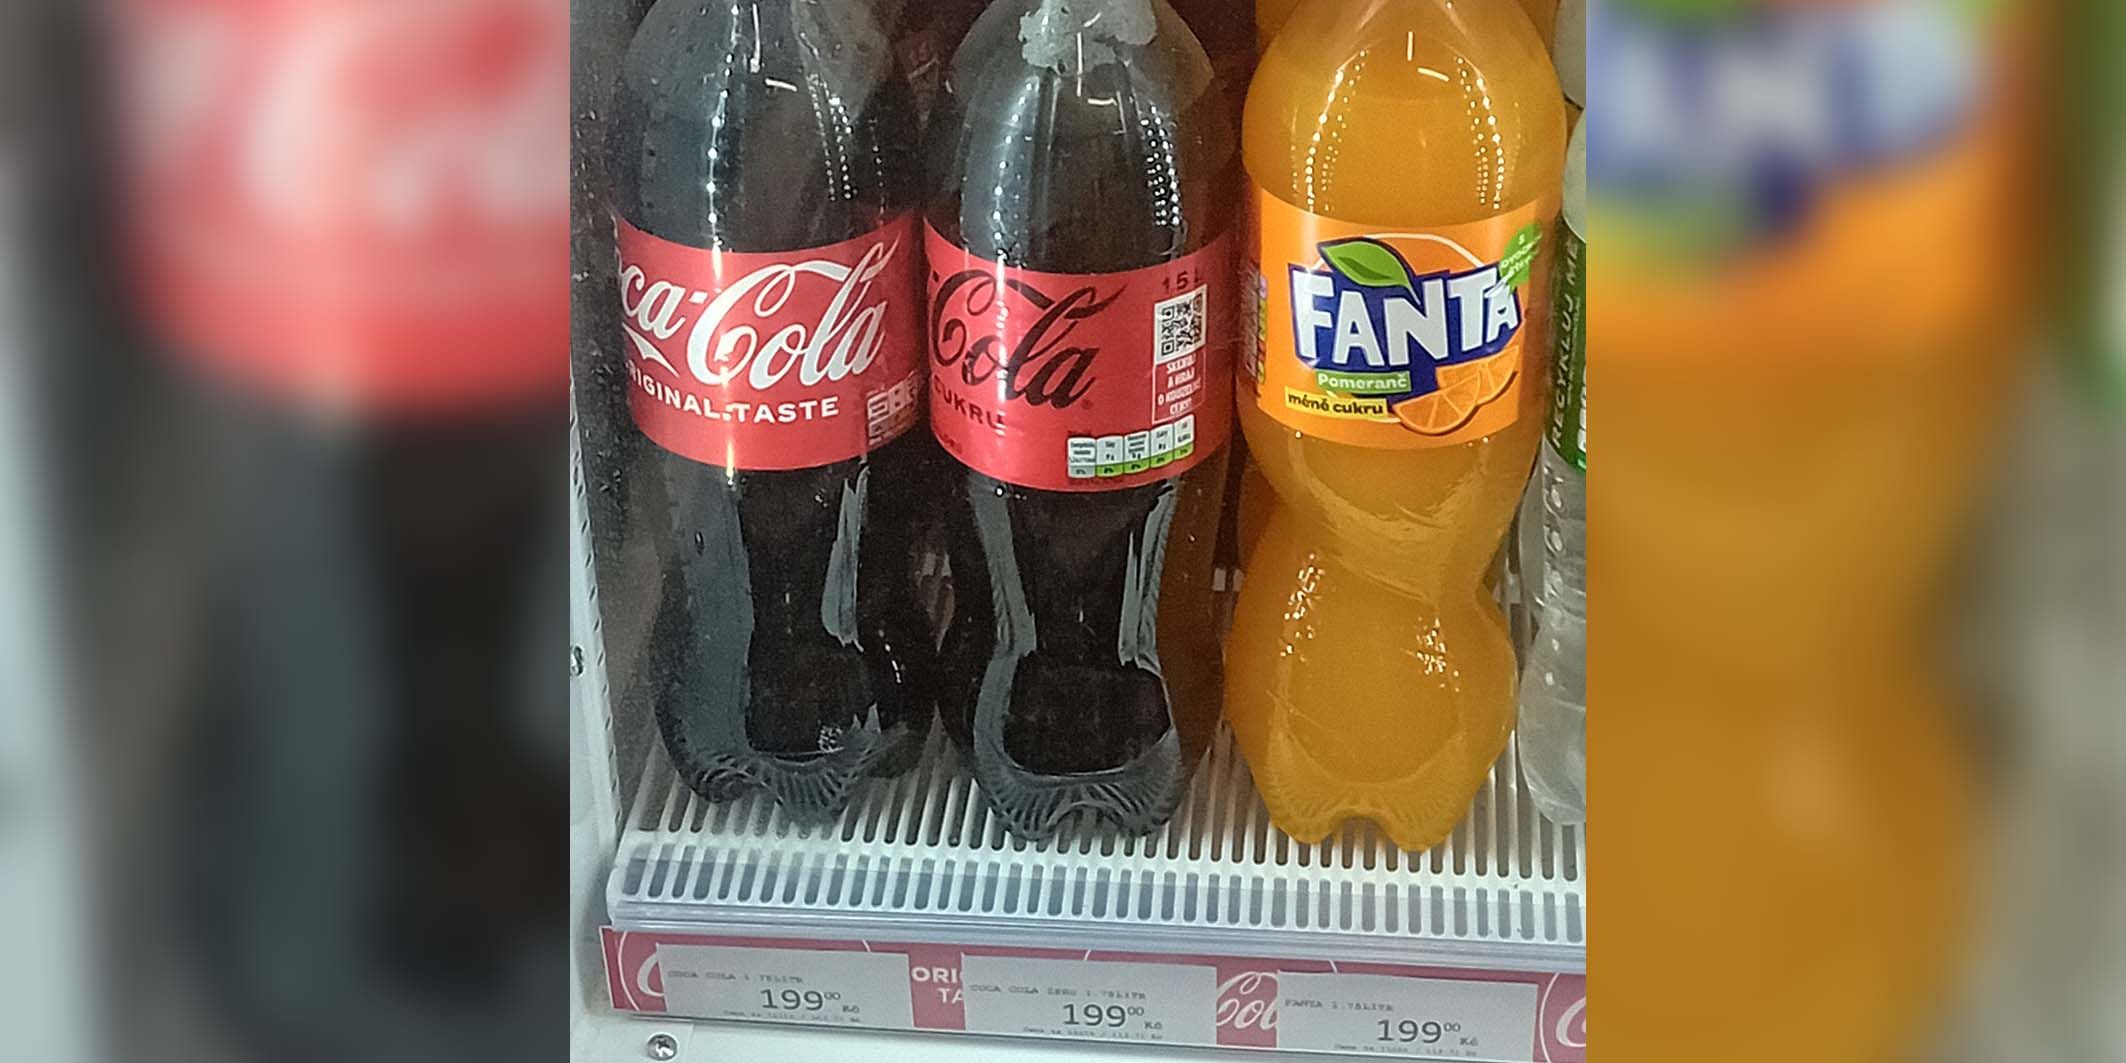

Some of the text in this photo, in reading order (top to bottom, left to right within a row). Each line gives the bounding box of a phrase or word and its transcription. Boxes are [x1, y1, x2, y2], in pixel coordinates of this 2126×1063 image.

[1291, 267, 1520, 367] FANTA
[625, 359, 723, 419] RIGINAL
[730, 397, 839, 423] TASTE
[1317, 372, 1408, 389] Pomeranč
[1333, 399, 1384, 414] cukru
[911, 966, 962, 984] ORI
[761, 989, 824, 1011] 199
[1063, 1003, 1126, 1027] 199
[1377, 1019, 1442, 1044] 199
